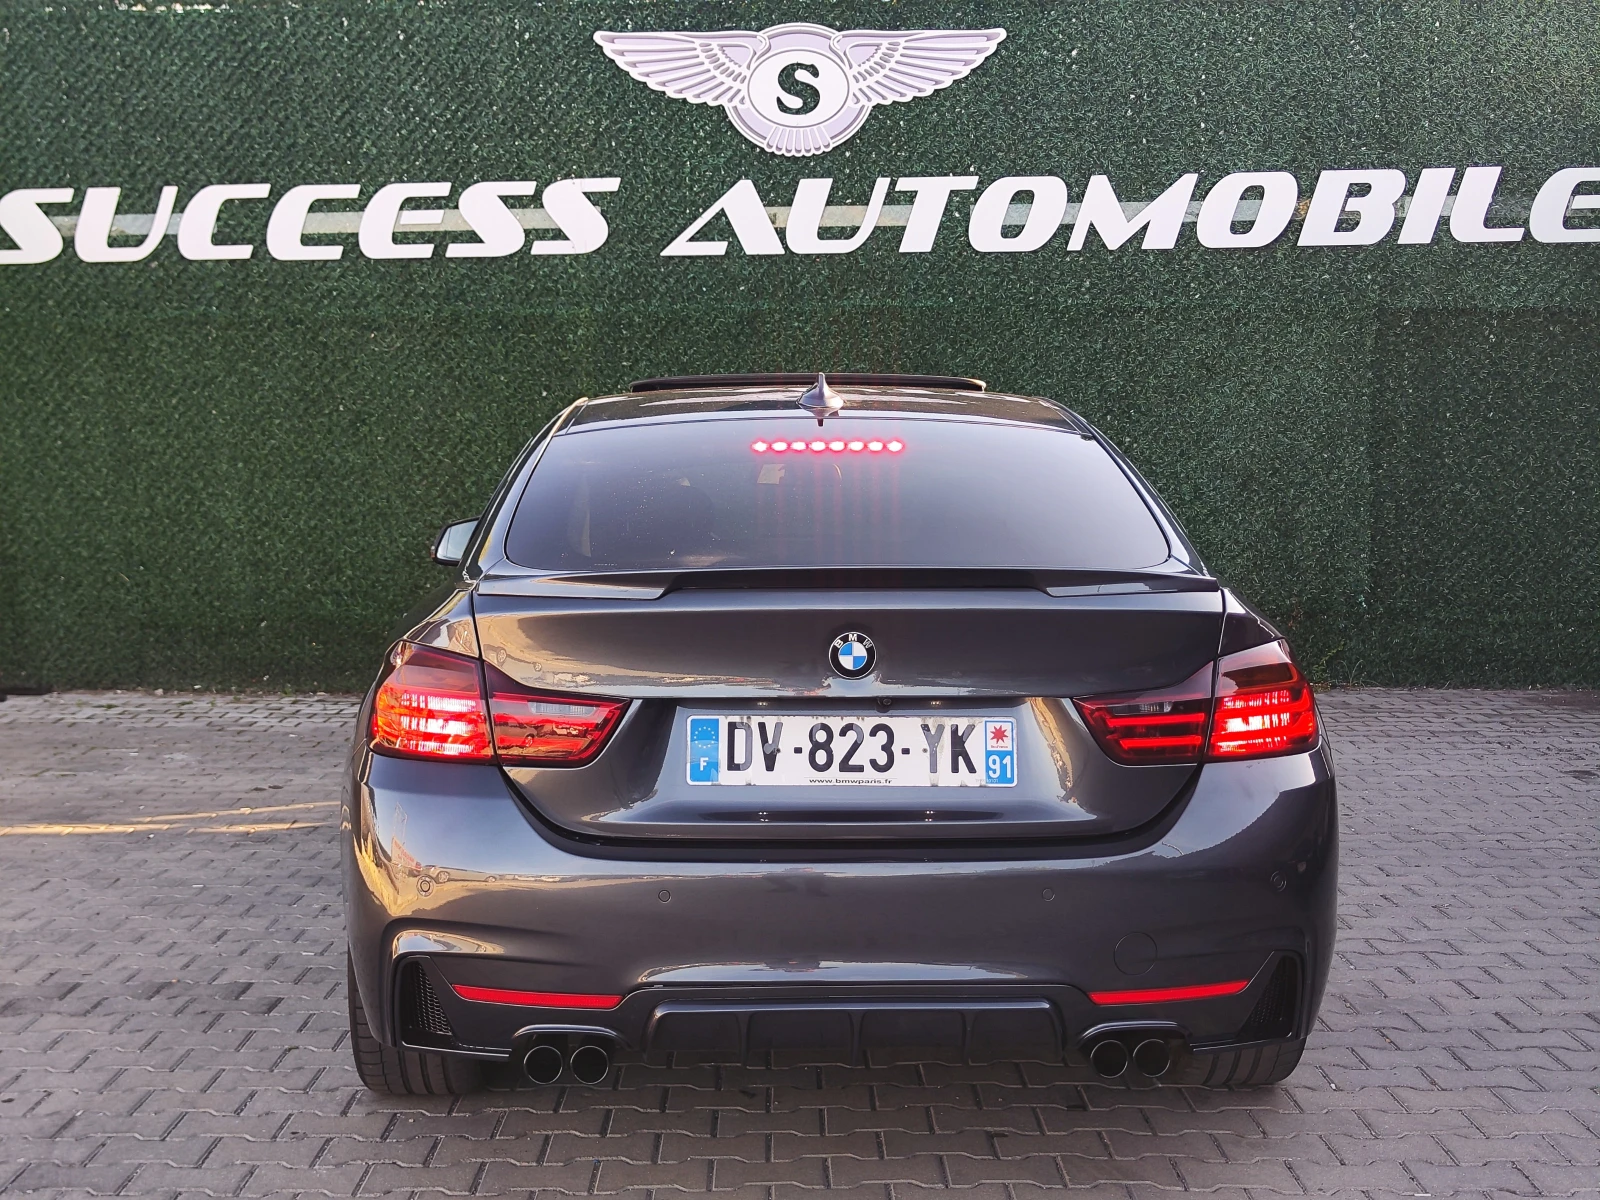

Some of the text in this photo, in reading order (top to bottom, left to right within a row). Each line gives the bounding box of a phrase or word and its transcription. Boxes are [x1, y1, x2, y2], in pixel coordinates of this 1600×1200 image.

[776, 62, 821, 115] S
[0, 166, 1600, 264] SUCCESS AUTOMOBILE
[833, 633, 873, 649] BMW
[700, 757, 709, 771] F
[988, 755, 1012, 779] 91
